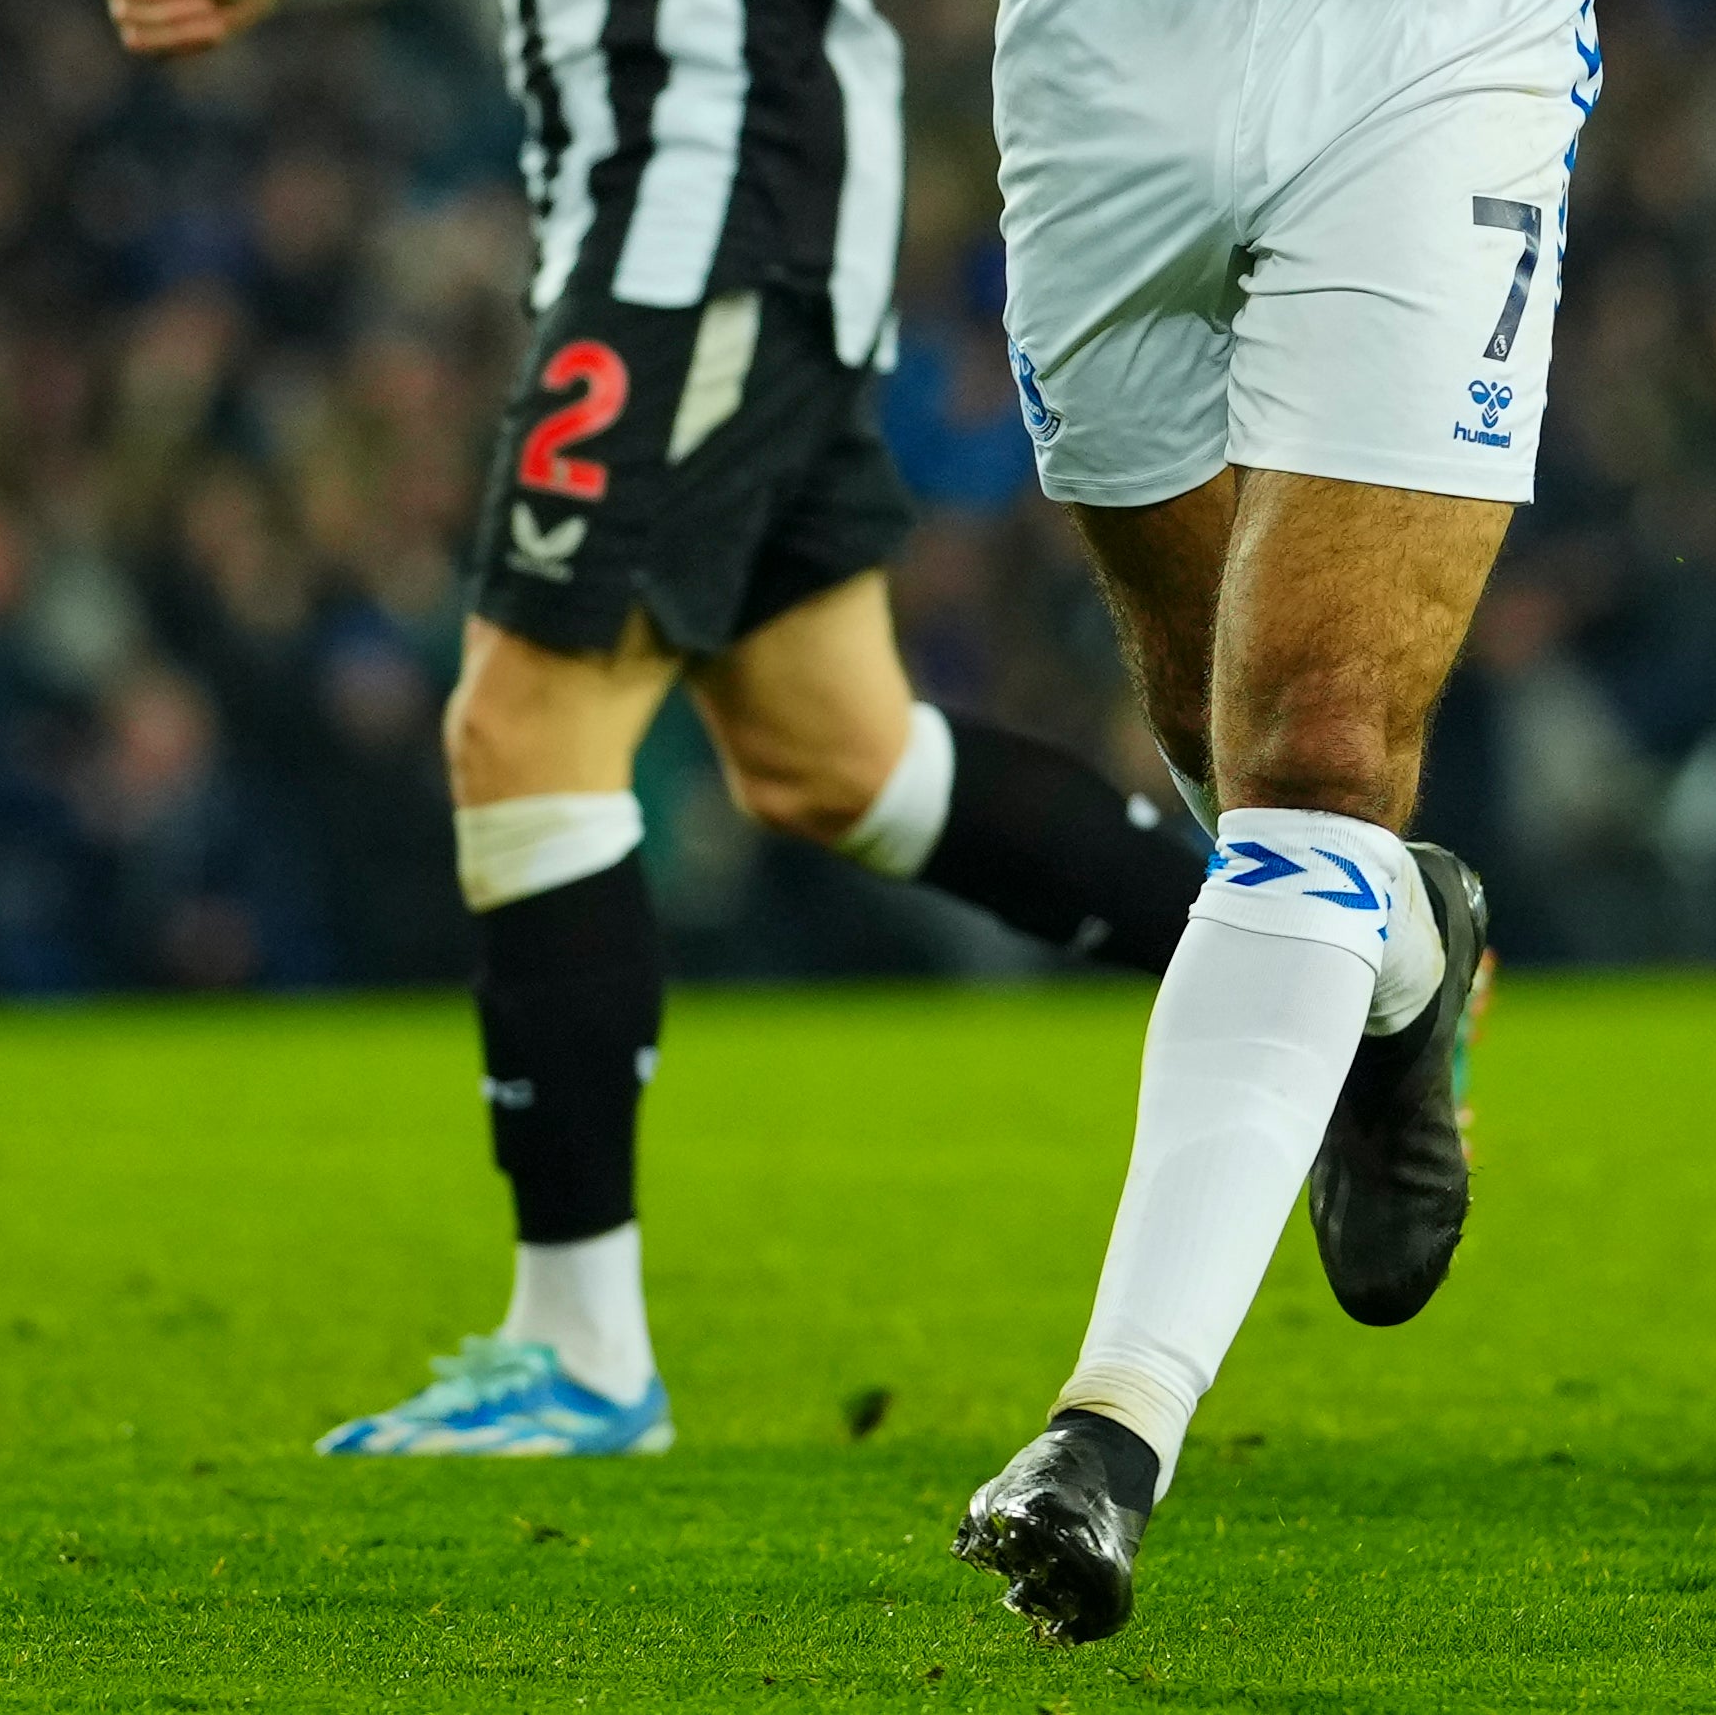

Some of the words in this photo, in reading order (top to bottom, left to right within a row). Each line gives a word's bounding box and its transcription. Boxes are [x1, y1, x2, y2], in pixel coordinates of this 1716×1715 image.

[1473, 196, 1541, 362] 7
[520, 339, 631, 501] 2
[1453, 421, 1512, 449] hummel
